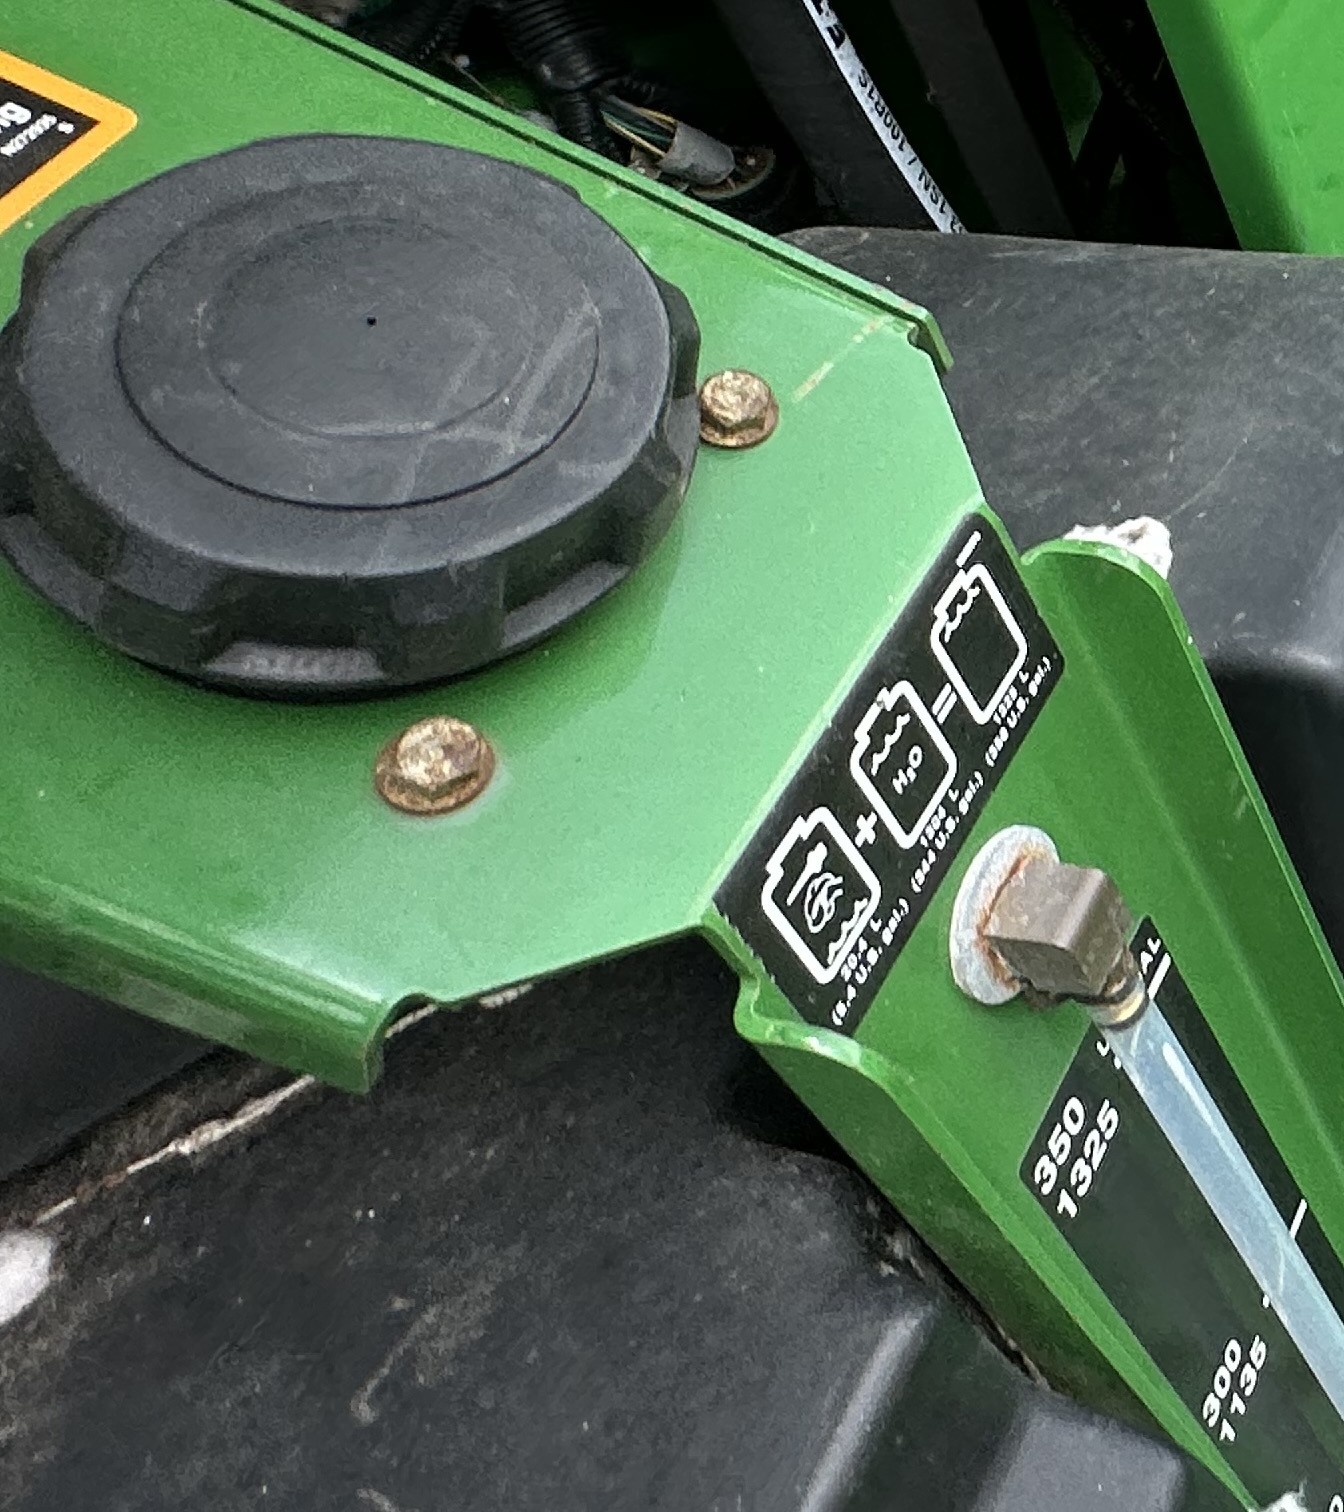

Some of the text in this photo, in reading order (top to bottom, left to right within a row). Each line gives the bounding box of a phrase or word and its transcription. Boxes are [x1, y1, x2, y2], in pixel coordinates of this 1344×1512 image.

[869, 918, 882, 932] L
[1034, 1096, 1085, 1196] 350
[1056, 1098, 1119, 1219] 1325
[1202, 1338, 1242, 1428] 300
[1219, 1334, 1267, 1442] 1135
